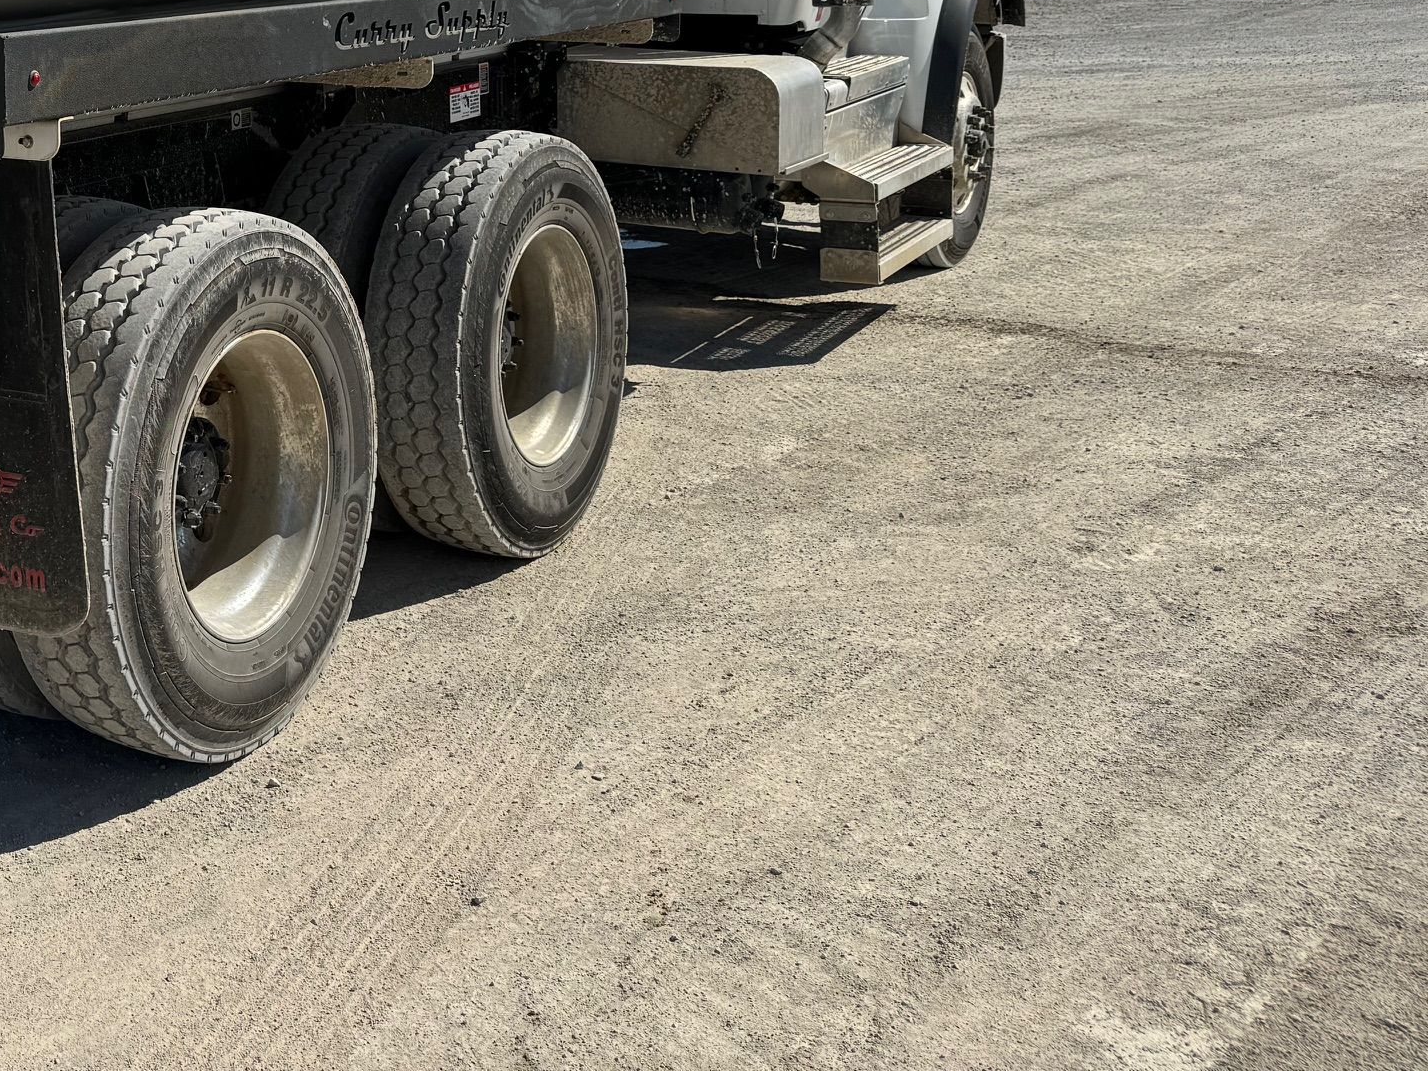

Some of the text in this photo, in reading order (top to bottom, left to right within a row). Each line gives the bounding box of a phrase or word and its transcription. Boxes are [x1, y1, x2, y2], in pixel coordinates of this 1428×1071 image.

[334, 0, 511, 54] Curry Supply
[498, 188, 547, 298] Continental
[261, 276, 332, 323] 11 R 22.5
[304, 494, 364, 658] Continental
